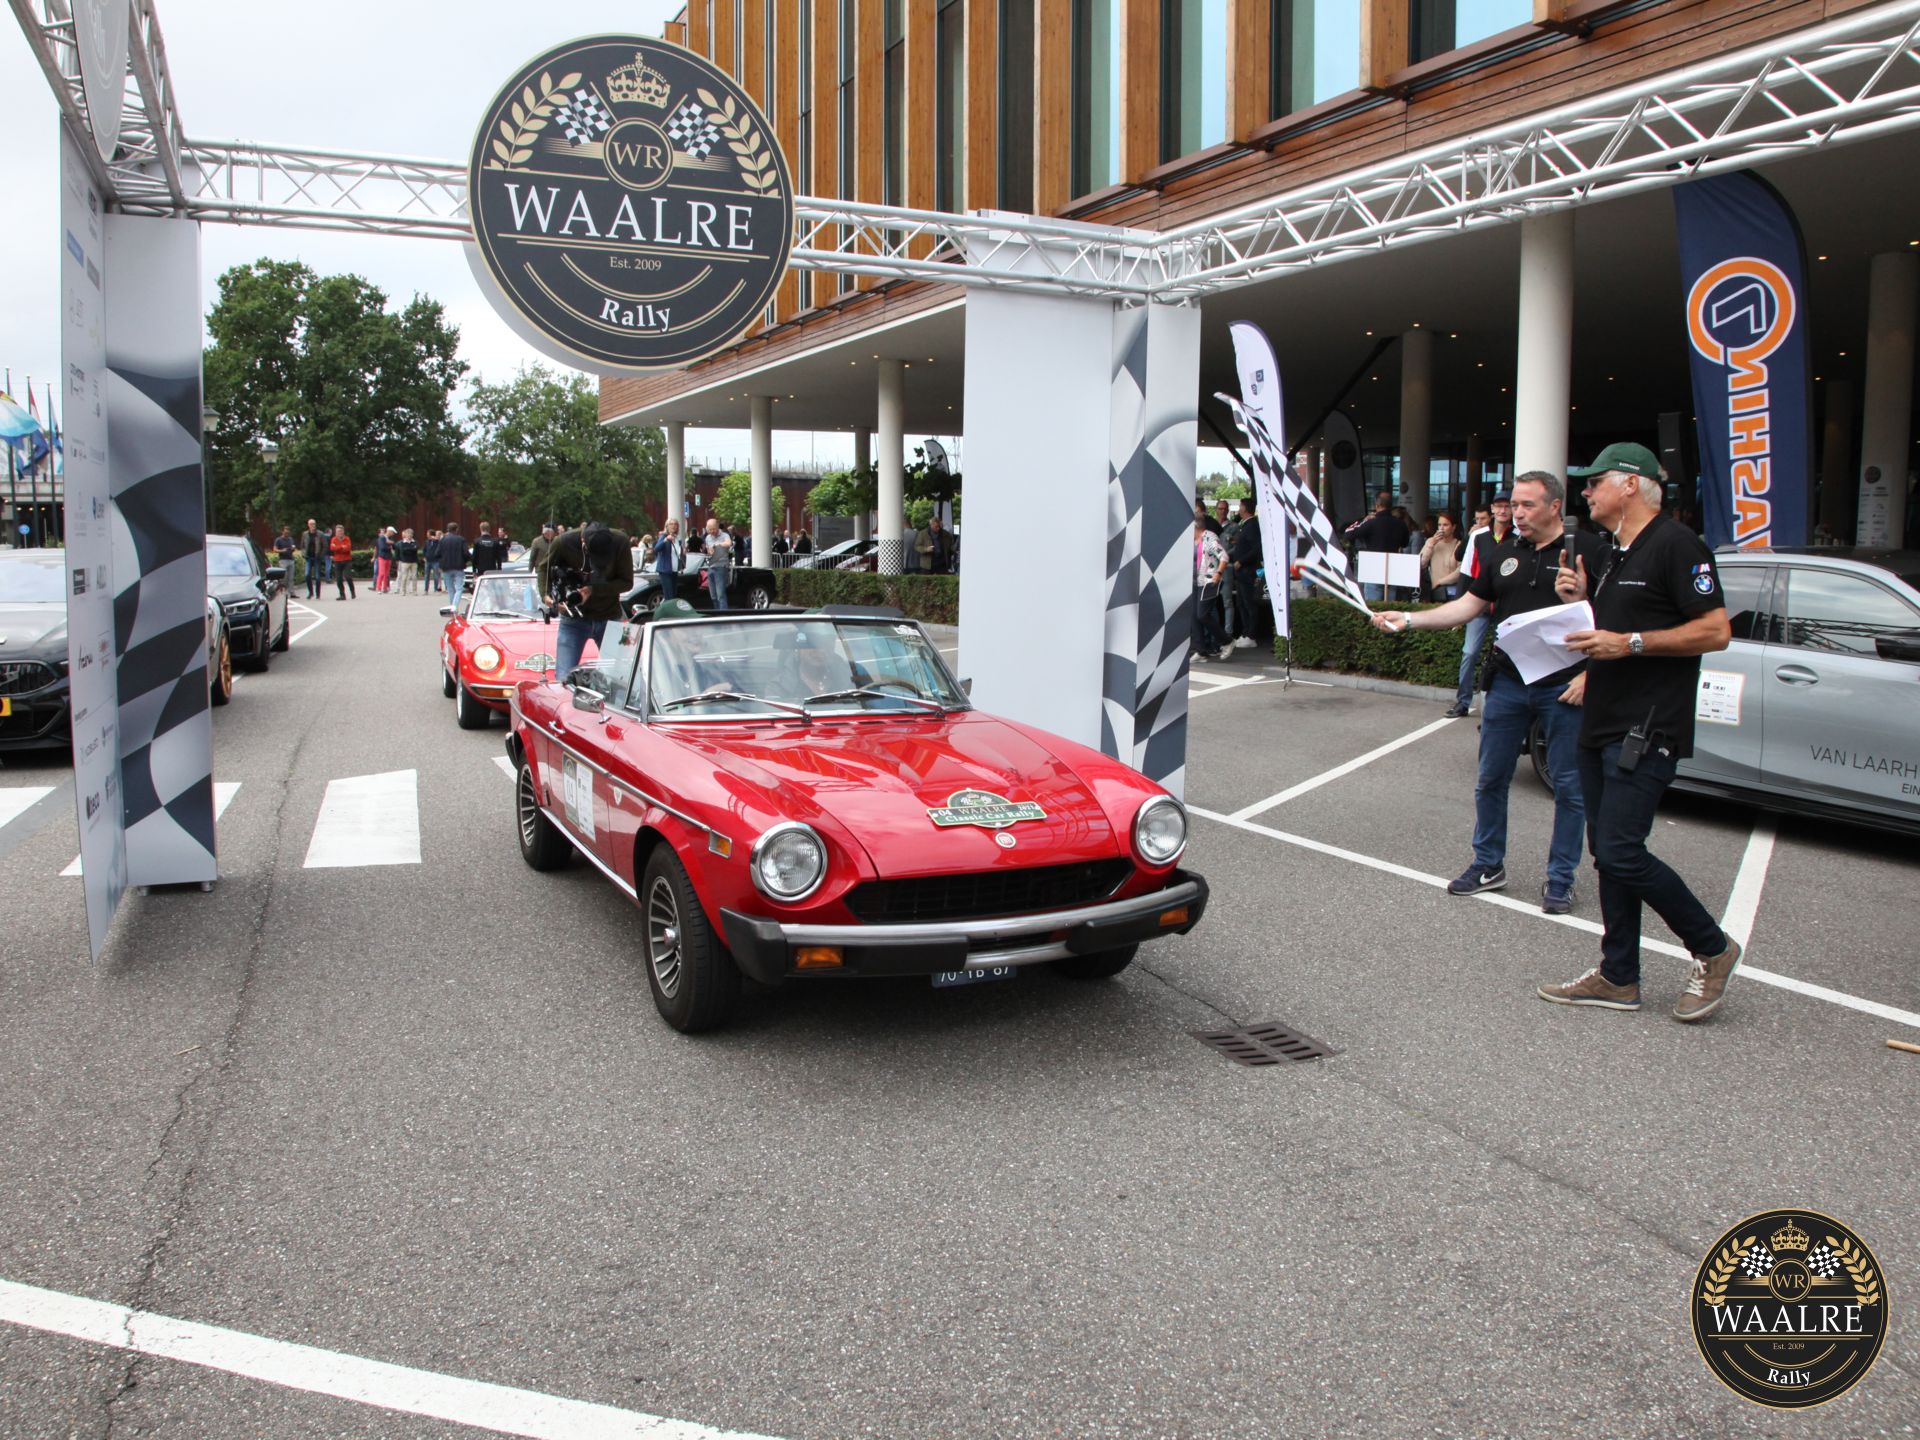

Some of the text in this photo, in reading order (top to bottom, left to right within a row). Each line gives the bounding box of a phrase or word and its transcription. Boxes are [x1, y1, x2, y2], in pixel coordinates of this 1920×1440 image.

[612, 142, 665, 170] WR
[504, 183, 754, 251] WAALRE
[610, 256, 662, 271] Est. 2009
[600, 297, 671, 332] Rally
[1810, 744, 1918, 780] VAN LAARH
[938, 809, 953, 817] 04
[958, 805, 1009, 815] WAALRE
[945, 809, 1035, 822] Classic Car Rally
